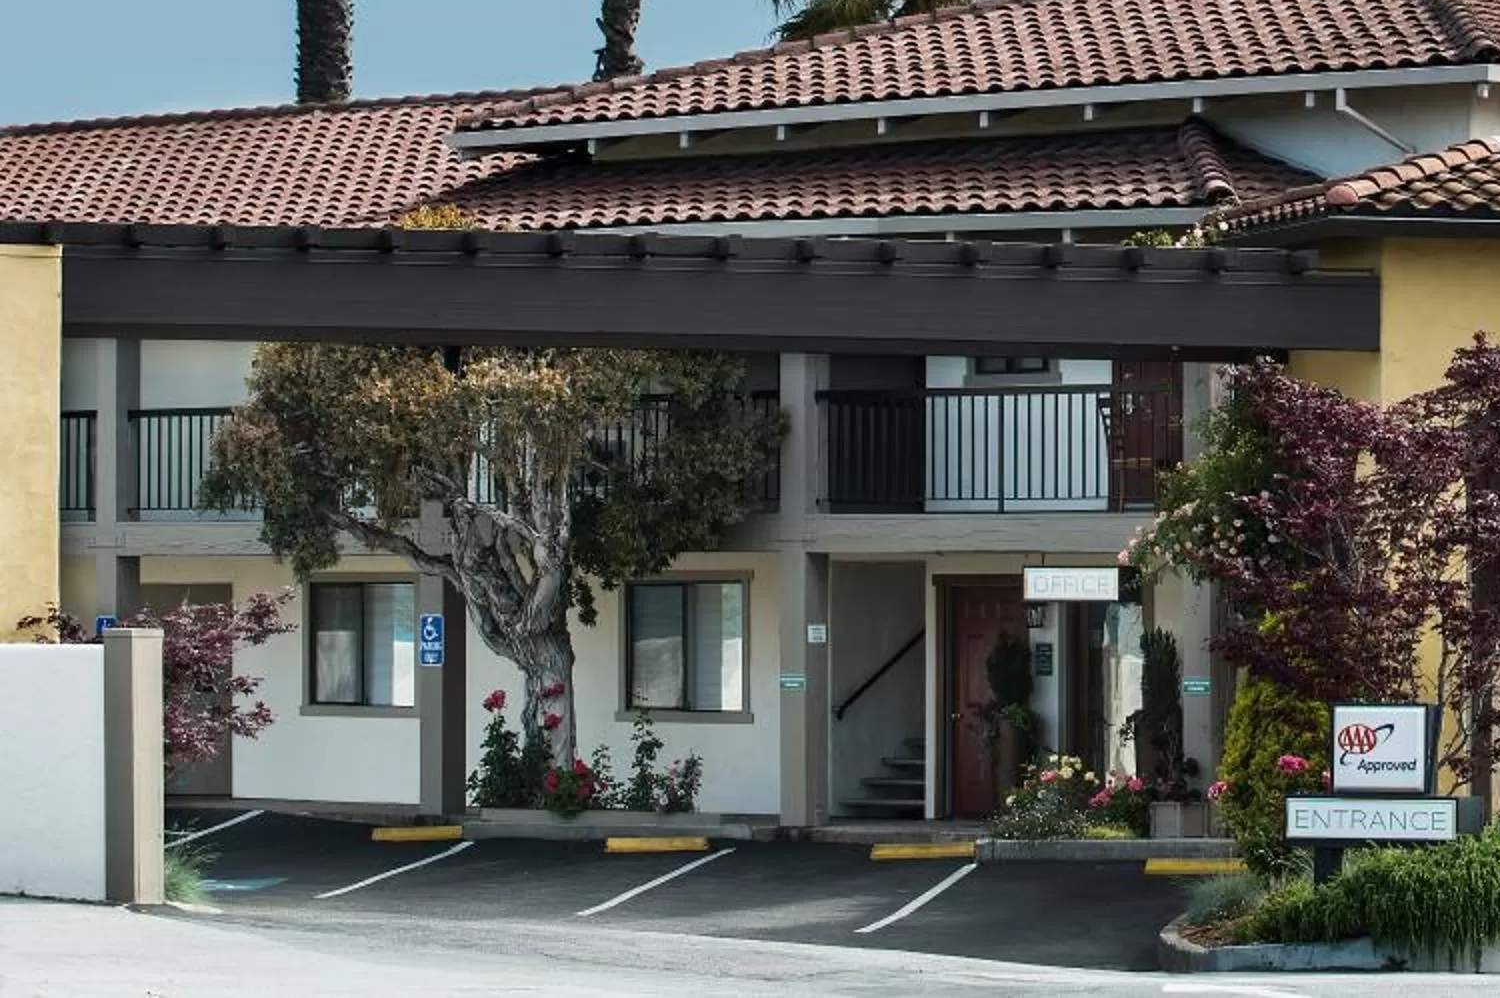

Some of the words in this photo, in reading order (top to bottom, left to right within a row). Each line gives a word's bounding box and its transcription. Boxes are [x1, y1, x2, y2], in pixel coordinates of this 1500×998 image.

[1034, 575, 1109, 594] OFFICE
[1340, 725, 1375, 754] AAA
[1357, 759, 1417, 775] Approved
[1295, 809, 1447, 831] ENTRANCE
